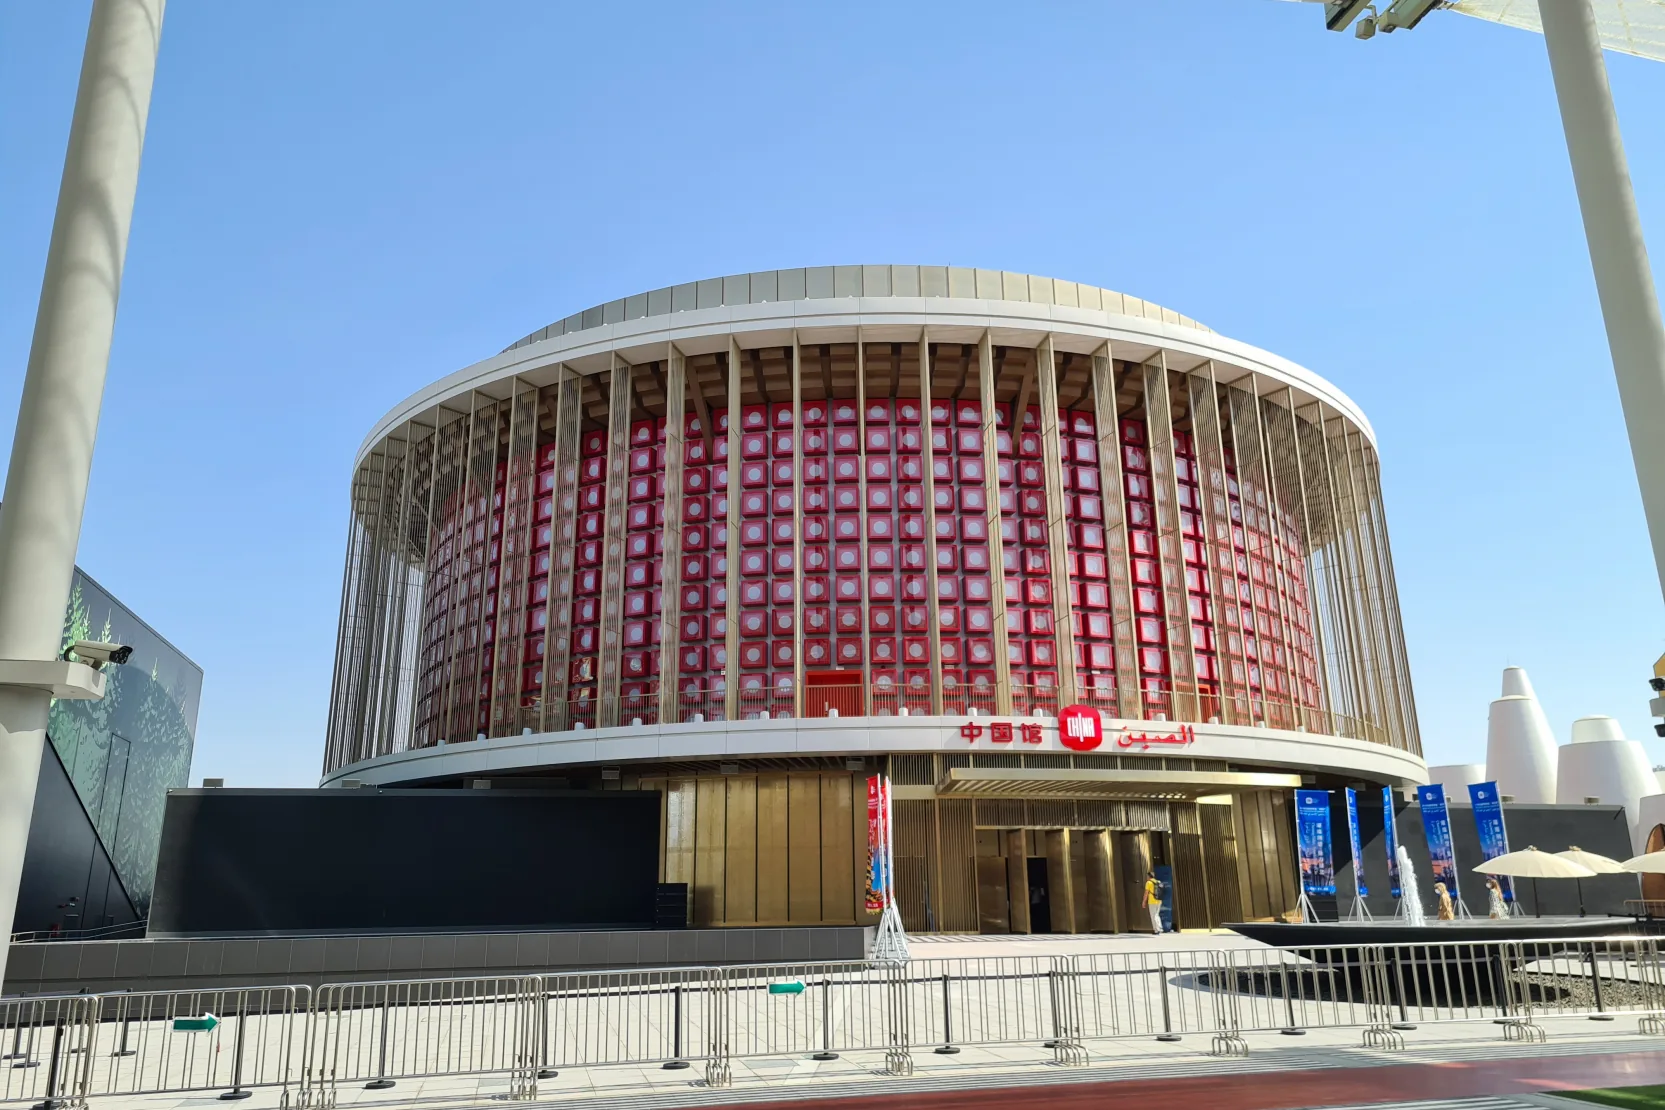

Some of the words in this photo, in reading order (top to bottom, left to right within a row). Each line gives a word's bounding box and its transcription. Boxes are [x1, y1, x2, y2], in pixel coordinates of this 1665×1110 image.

[960, 721, 1042, 743] 中国馆
[1067, 713, 1095, 742] CHINA
[1118, 725, 1194, 749] الصين
